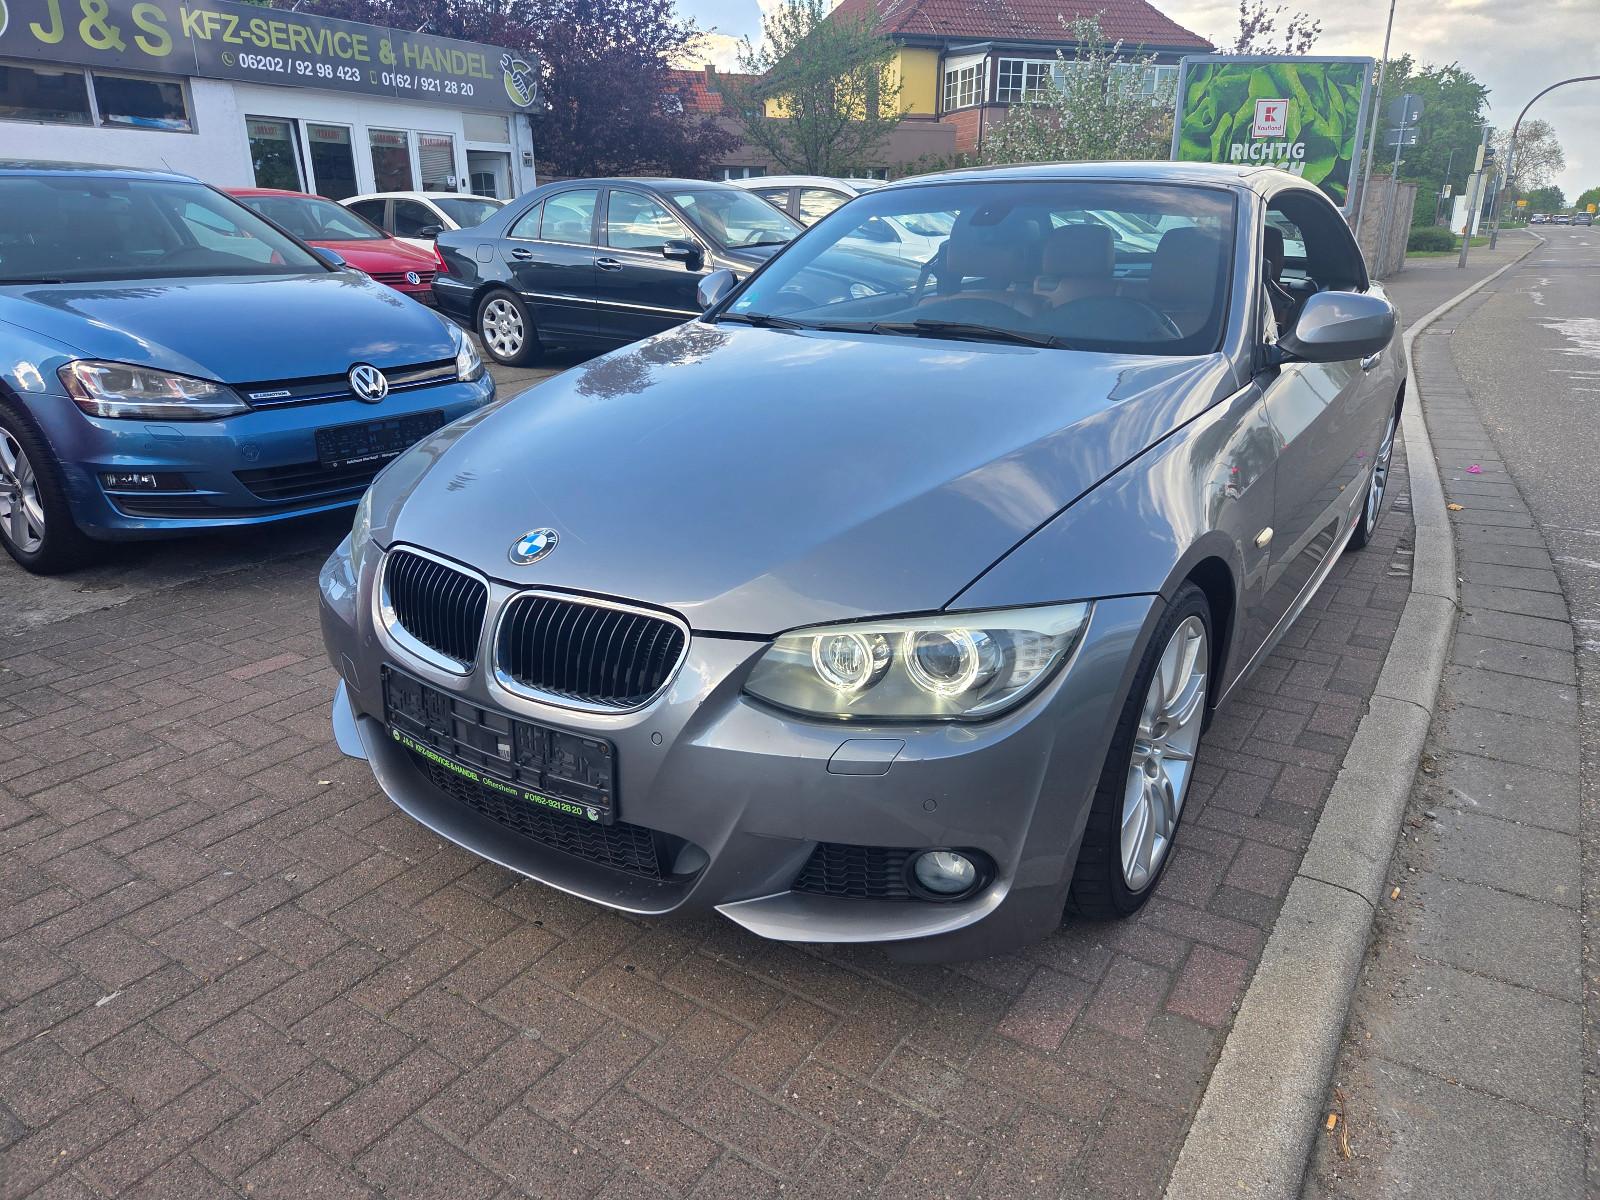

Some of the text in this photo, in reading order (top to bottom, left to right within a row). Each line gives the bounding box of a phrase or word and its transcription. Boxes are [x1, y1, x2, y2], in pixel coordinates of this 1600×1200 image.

[180, 7, 494, 80] KFZ-SERVICE & HANDEL
[238, 53, 284, 73] 06202
[295, 60, 314, 76] 92
[316, 63, 334, 79] 98
[336, 65, 361, 82] 423
[381, 71, 412, 88] 0162
[421, 77, 441, 93] 921
[444, 80, 458, 95] 28
[460, 82, 474, 97] 20
[1230, 142, 1305, 160] RICHTIG
